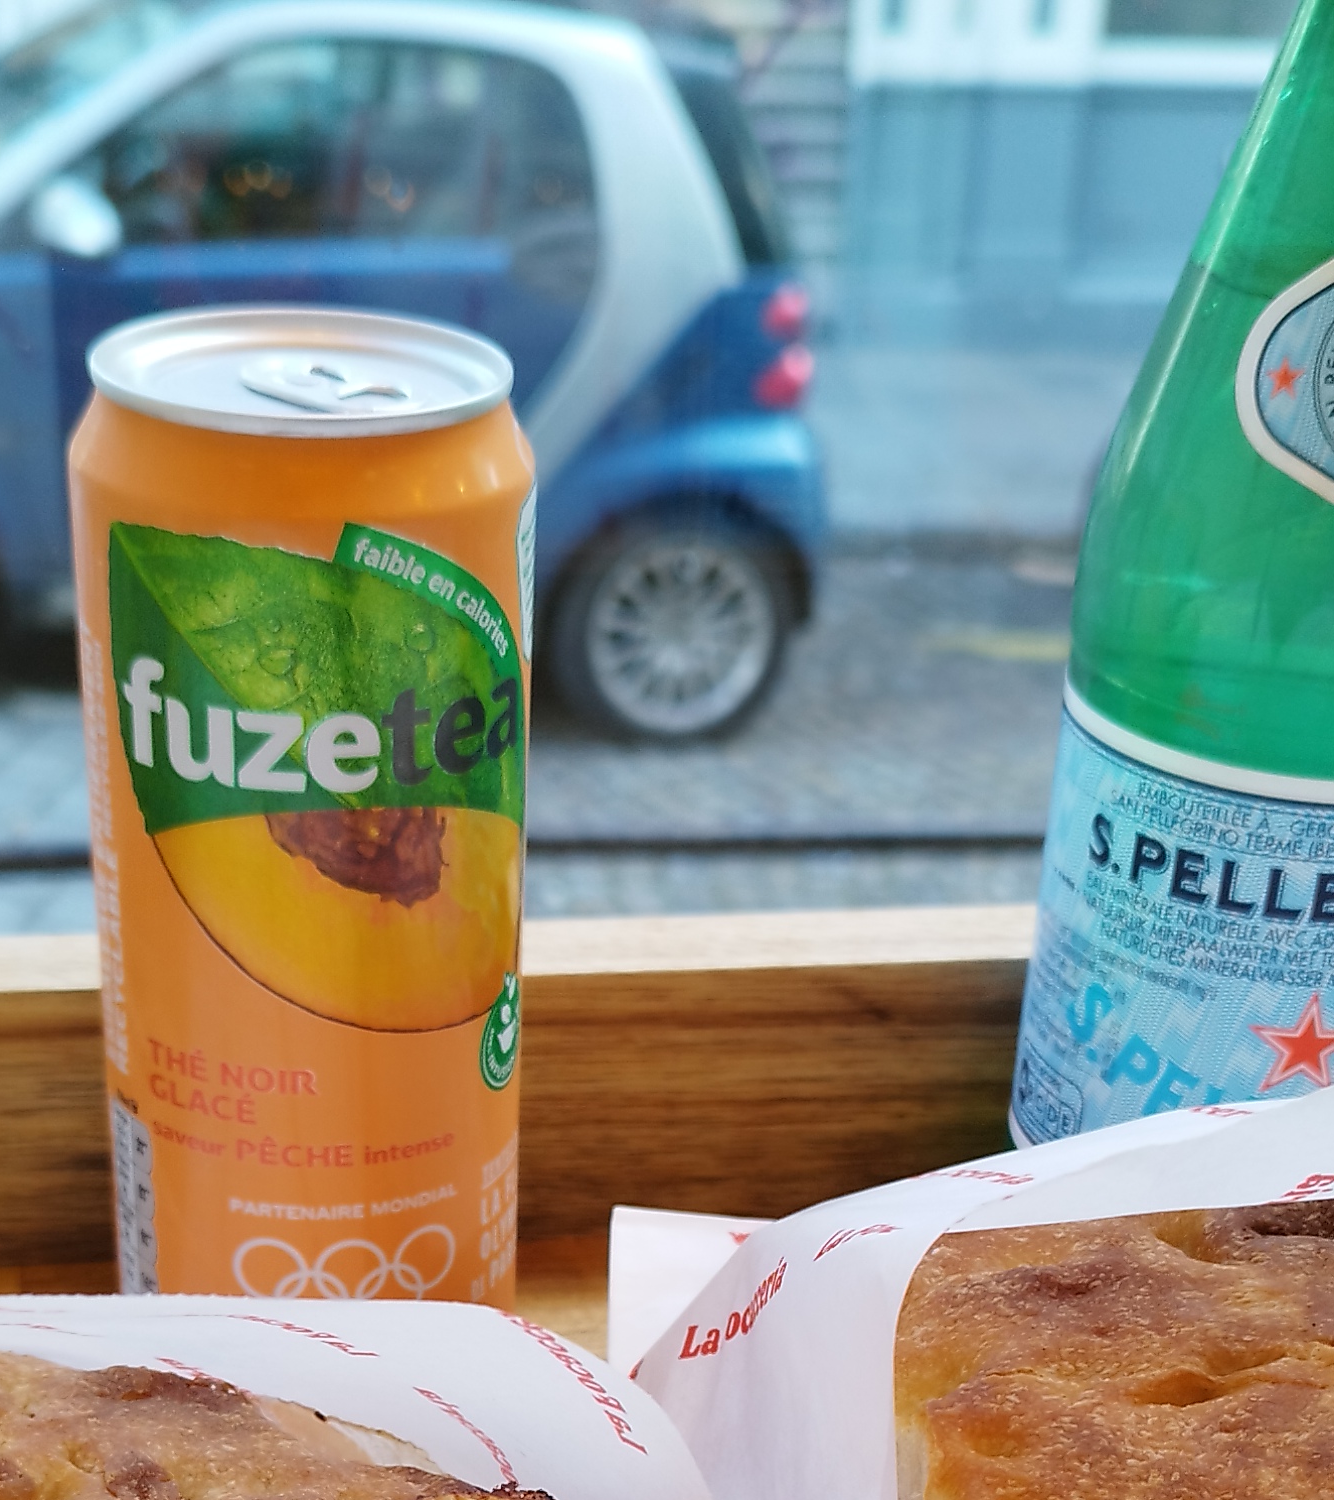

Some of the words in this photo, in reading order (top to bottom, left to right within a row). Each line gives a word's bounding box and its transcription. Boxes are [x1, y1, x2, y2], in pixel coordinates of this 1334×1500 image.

[353, 537, 426, 588] faible
[428, 571, 455, 601] en
[455, 590, 511, 659] calories
[1245, 830, 1305, 856] TERME
[1176, 908, 1260, 943] NATURELLE
[1264, 926, 1306, 950] AVEC
[147, 1037, 209, 1082] THÉ
[219, 1061, 317, 1097] NOIR
[149, 1073, 257, 1126] GLACÉ
[152, 1120, 227, 1158] saveur
[235, 1135, 354, 1170] PÊCHE
[364, 1131, 456, 1168] intense
[228, 1195, 365, 1223] PARTENAIRE
[370, 1183, 459, 1217] MONDIAL
[679, 1325, 721, 1360] La
